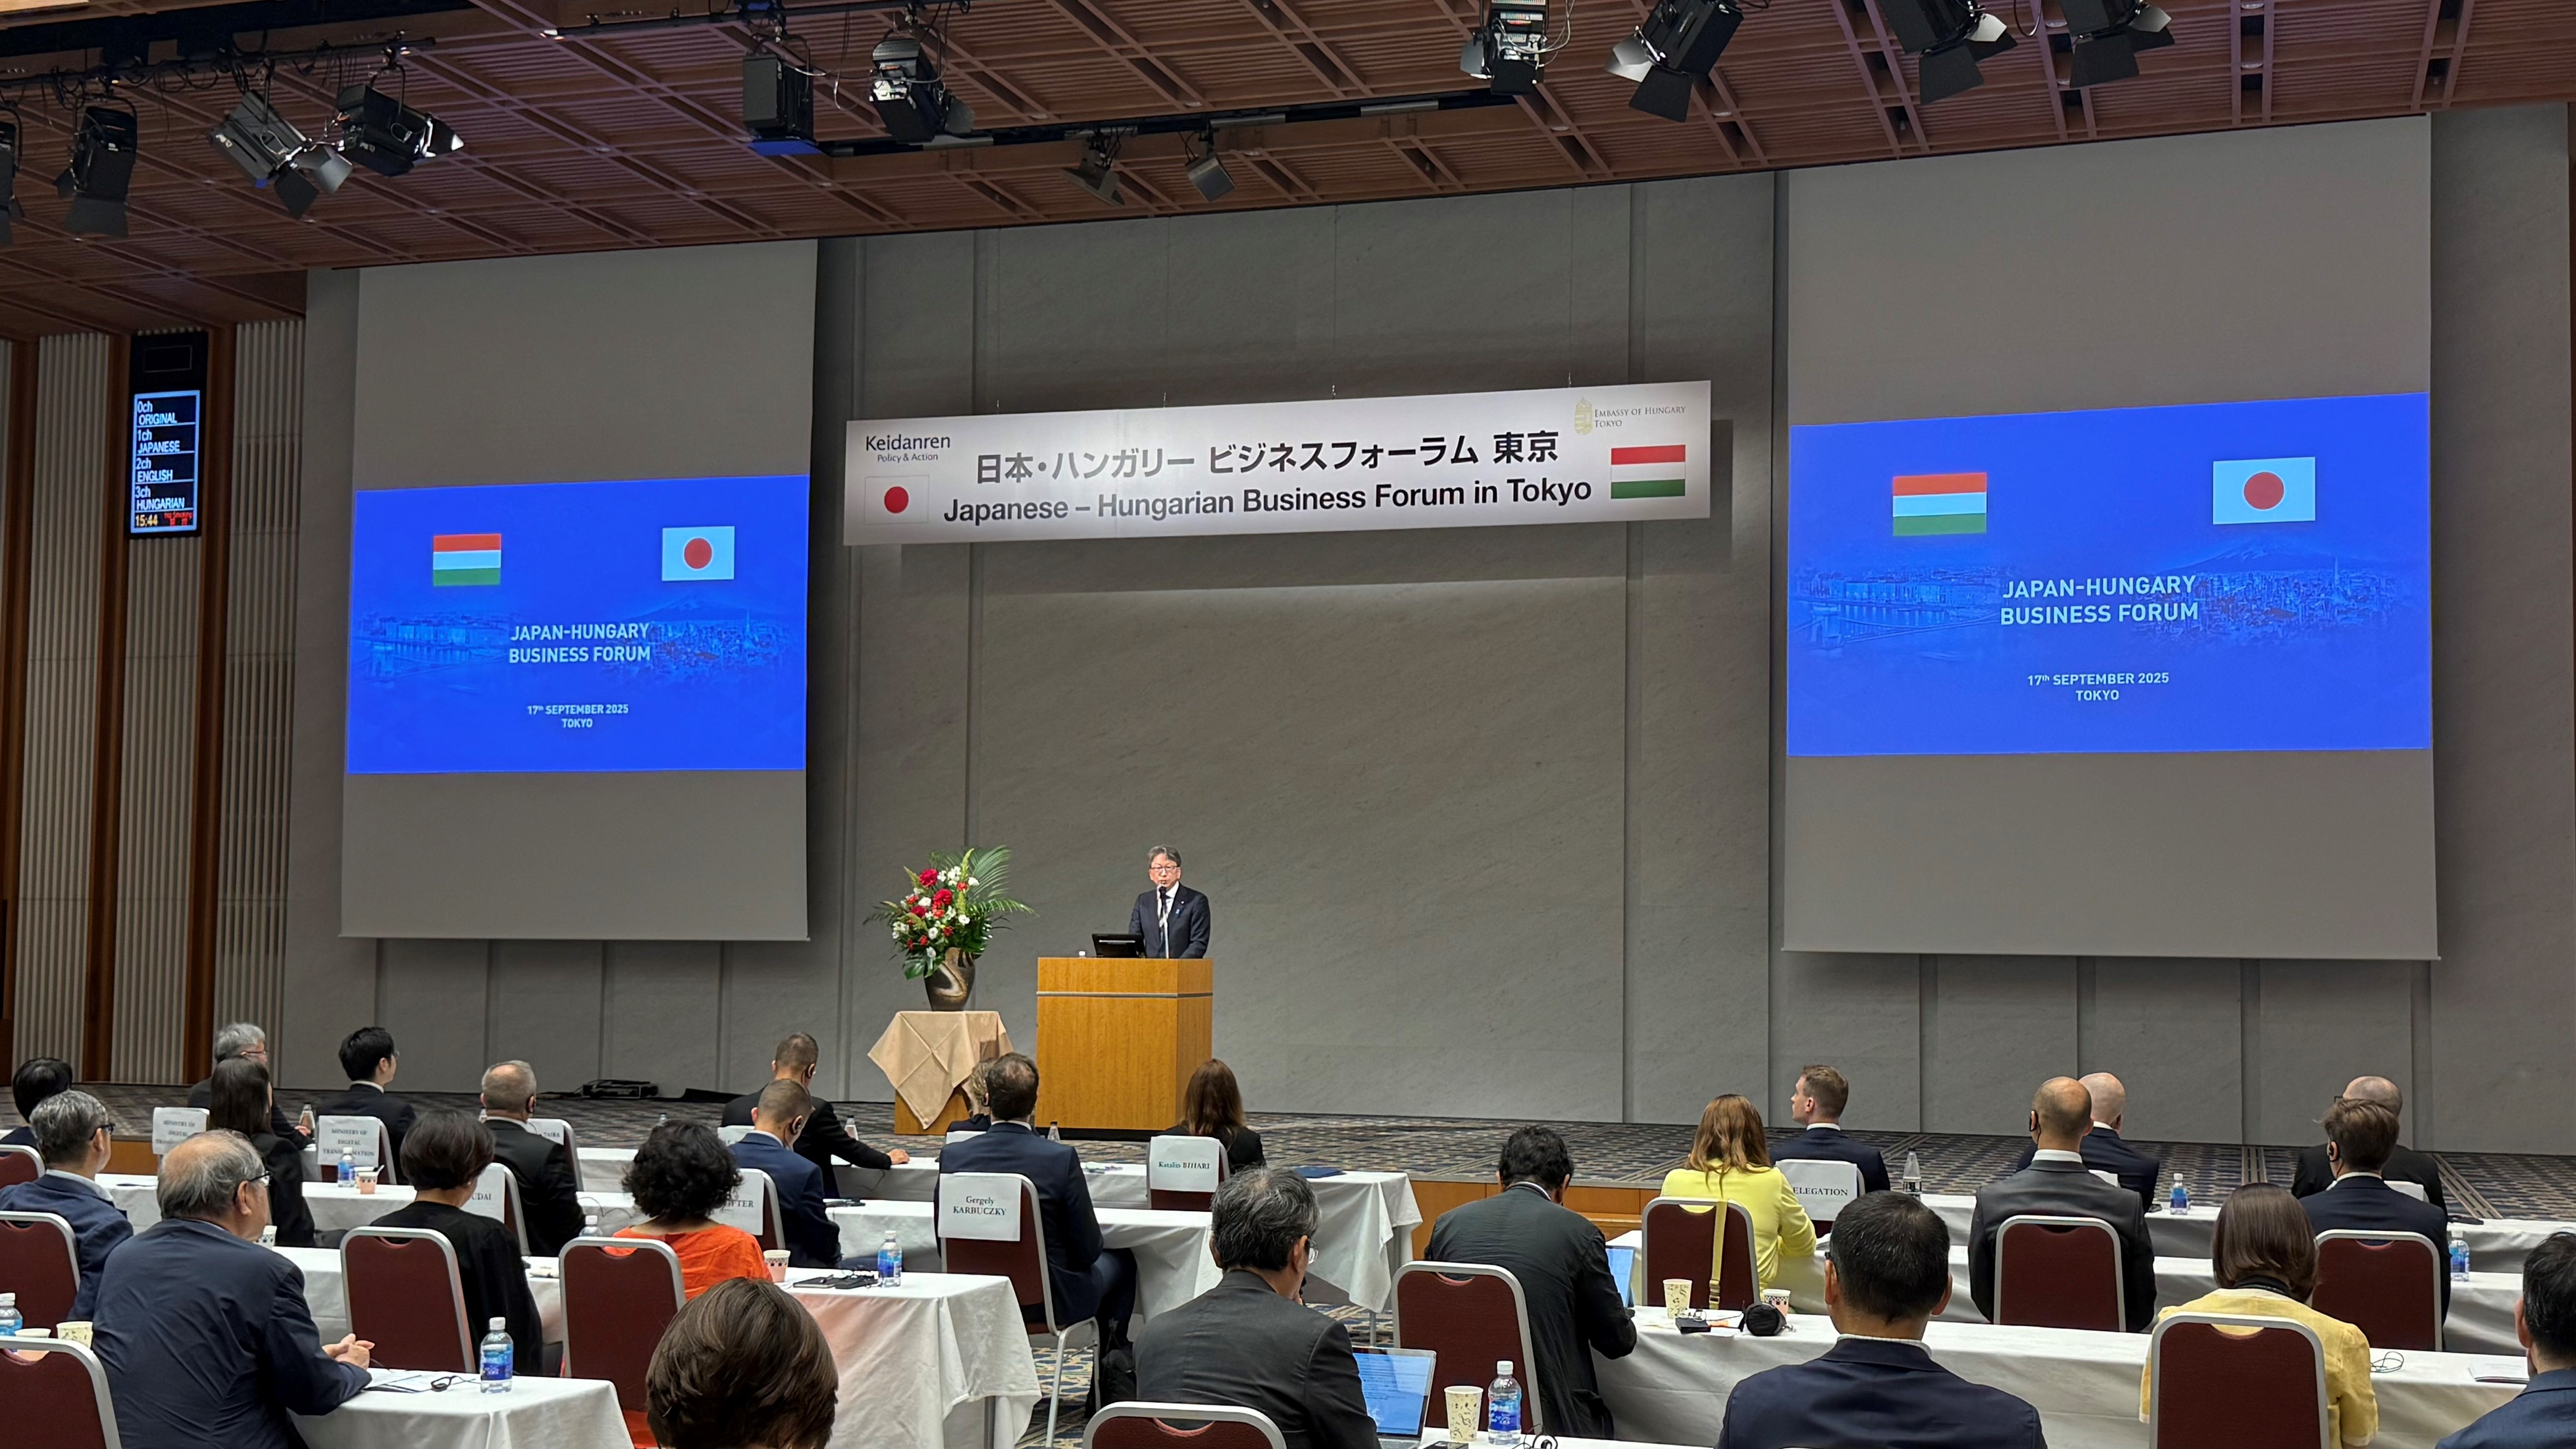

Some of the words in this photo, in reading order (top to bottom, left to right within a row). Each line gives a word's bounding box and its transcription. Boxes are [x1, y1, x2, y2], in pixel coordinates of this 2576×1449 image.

[138, 400, 153, 413] 0ch
[1595, 408, 1629, 417] EMBASSY
[1645, 406, 1686, 415] HUNGARY
[139, 412, 178, 425] ORIGINAL
[138, 429, 152, 441] 1ch
[138, 440, 180, 454] JAPANESE
[866, 434, 950, 451] Keidanren
[136, 457, 151, 470] 2ch
[877, 454, 901, 463] Policy
[911, 453, 938, 461] Action
[977, 447, 1195, 484] 日本・ハンガリー
[1210, 435, 1479, 473] ビジネスフォーラム
[1493, 430, 1559, 464] 東京
[138, 470, 173, 482] ENGLISH
[135, 485, 151, 498] 3ch
[136, 497, 185, 510] HUNGARIAN
[944, 498, 1069, 526] Japanese
[1098, 491, 1233, 521] Hungarian
[1244, 488, 1366, 512] Business
[1376, 484, 1464, 507] Forum
[1474, 480, 1498, 504] in
[1506, 477, 1592, 506] Tokyo
[136, 514, 158, 527] 15:44
[2003, 575, 2196, 598] JAPAN-HUNGARY
[2001, 605, 2111, 625] BUSINESS
[2119, 602, 2199, 622] FORUM
[510, 622, 650, 641] JAPAN-HUNGARY
[509, 647, 589, 663] BUSINESS
[593, 646, 650, 662] FORUM
[2028, 674, 2049, 686] 17th
[2053, 673, 2135, 686] SEPTEMBER
[2138, 672, 2169, 684] 2025
[2075, 689, 2120, 701] TOKYO
[527, 705, 544, 715] 17th
[545, 704, 604, 715] SEPTEMBER
[606, 704, 629, 714] 2025
[562, 718, 593, 728] TOKYO
[1792, 1187, 1848, 1196] ELEGATION
[966, 1195, 994, 1206] Gergely
[953, 1206, 1006, 1216] KARBUCZKY
